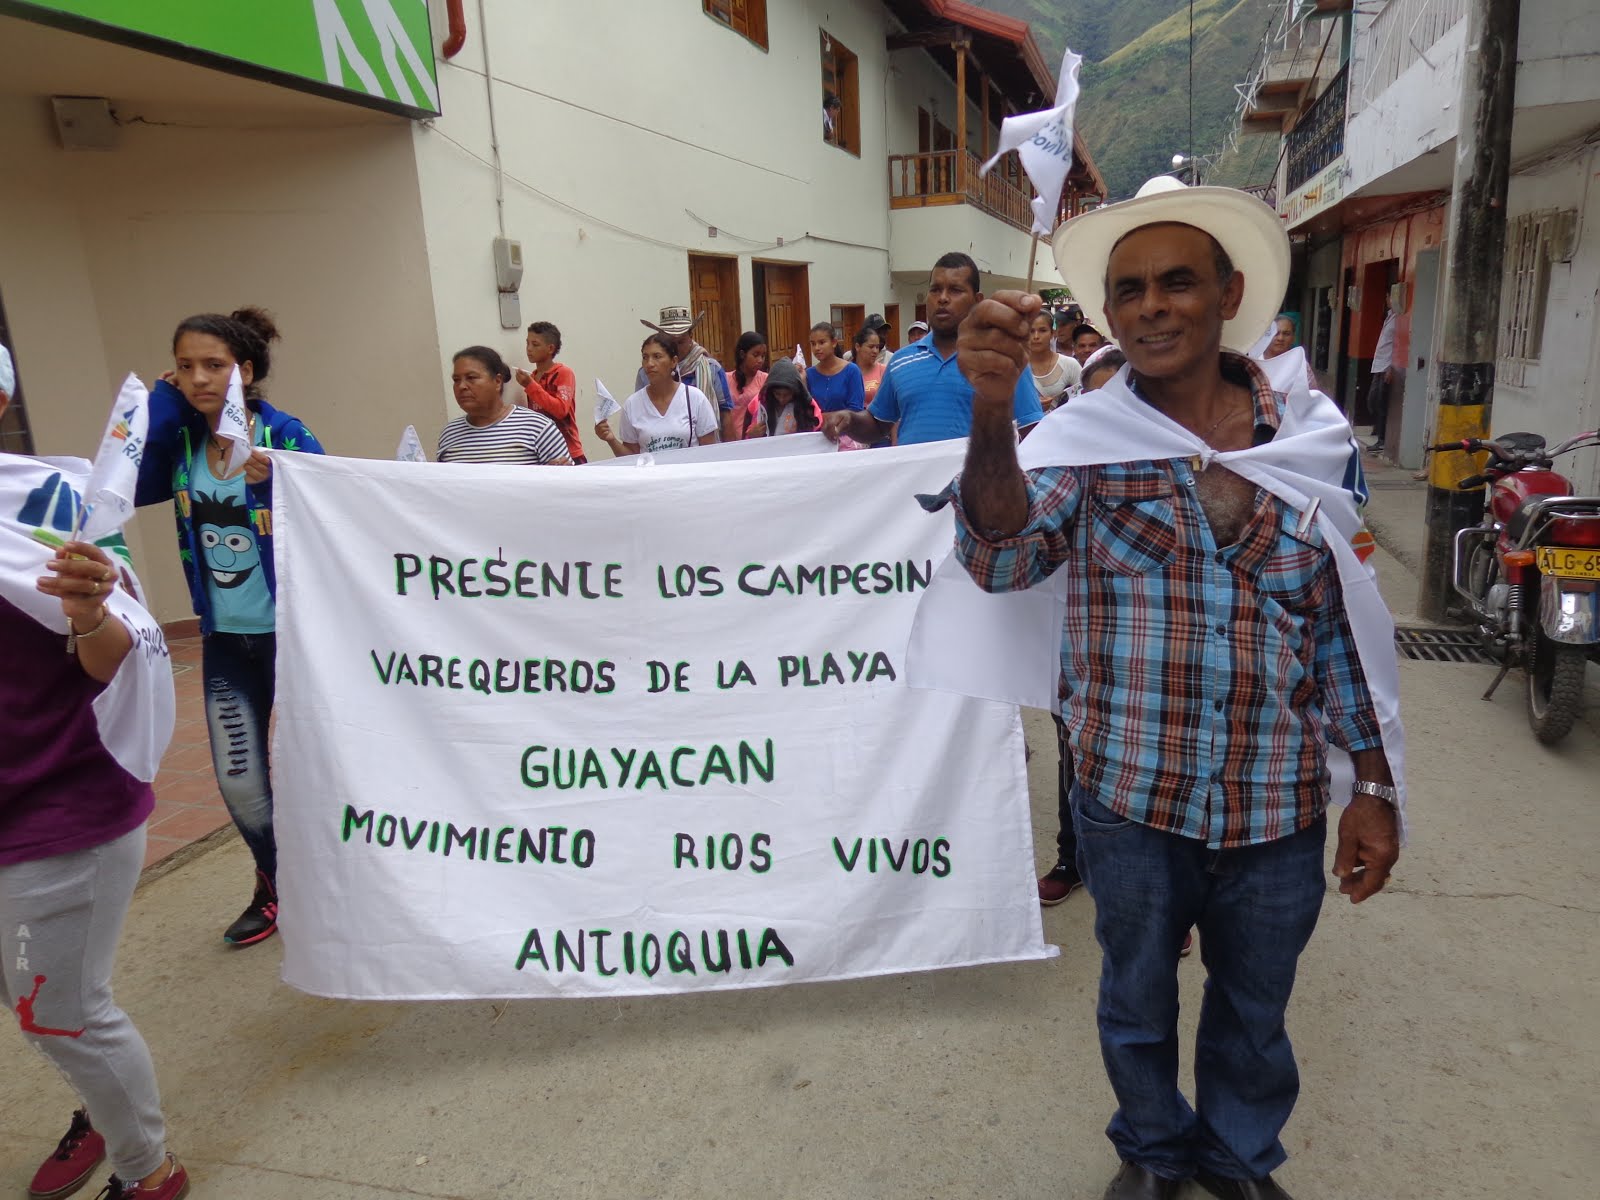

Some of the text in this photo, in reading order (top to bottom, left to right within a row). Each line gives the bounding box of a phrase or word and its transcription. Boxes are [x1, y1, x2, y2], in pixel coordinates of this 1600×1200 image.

[393, 547, 623, 600] PRESENTE
[657, 562, 724, 598] LOS
[647, 660, 690, 694] DE
[717, 659, 757, 690] LA
[778, 650, 896, 687] PLAYA
[520, 738, 775, 790] GUAYACAN
[341, 803, 951, 878] MOVIMIENTO RIOS VIVOS
[15, 923, 32, 971] AIR
[515, 927, 795, 978] ANTIOQUIA
